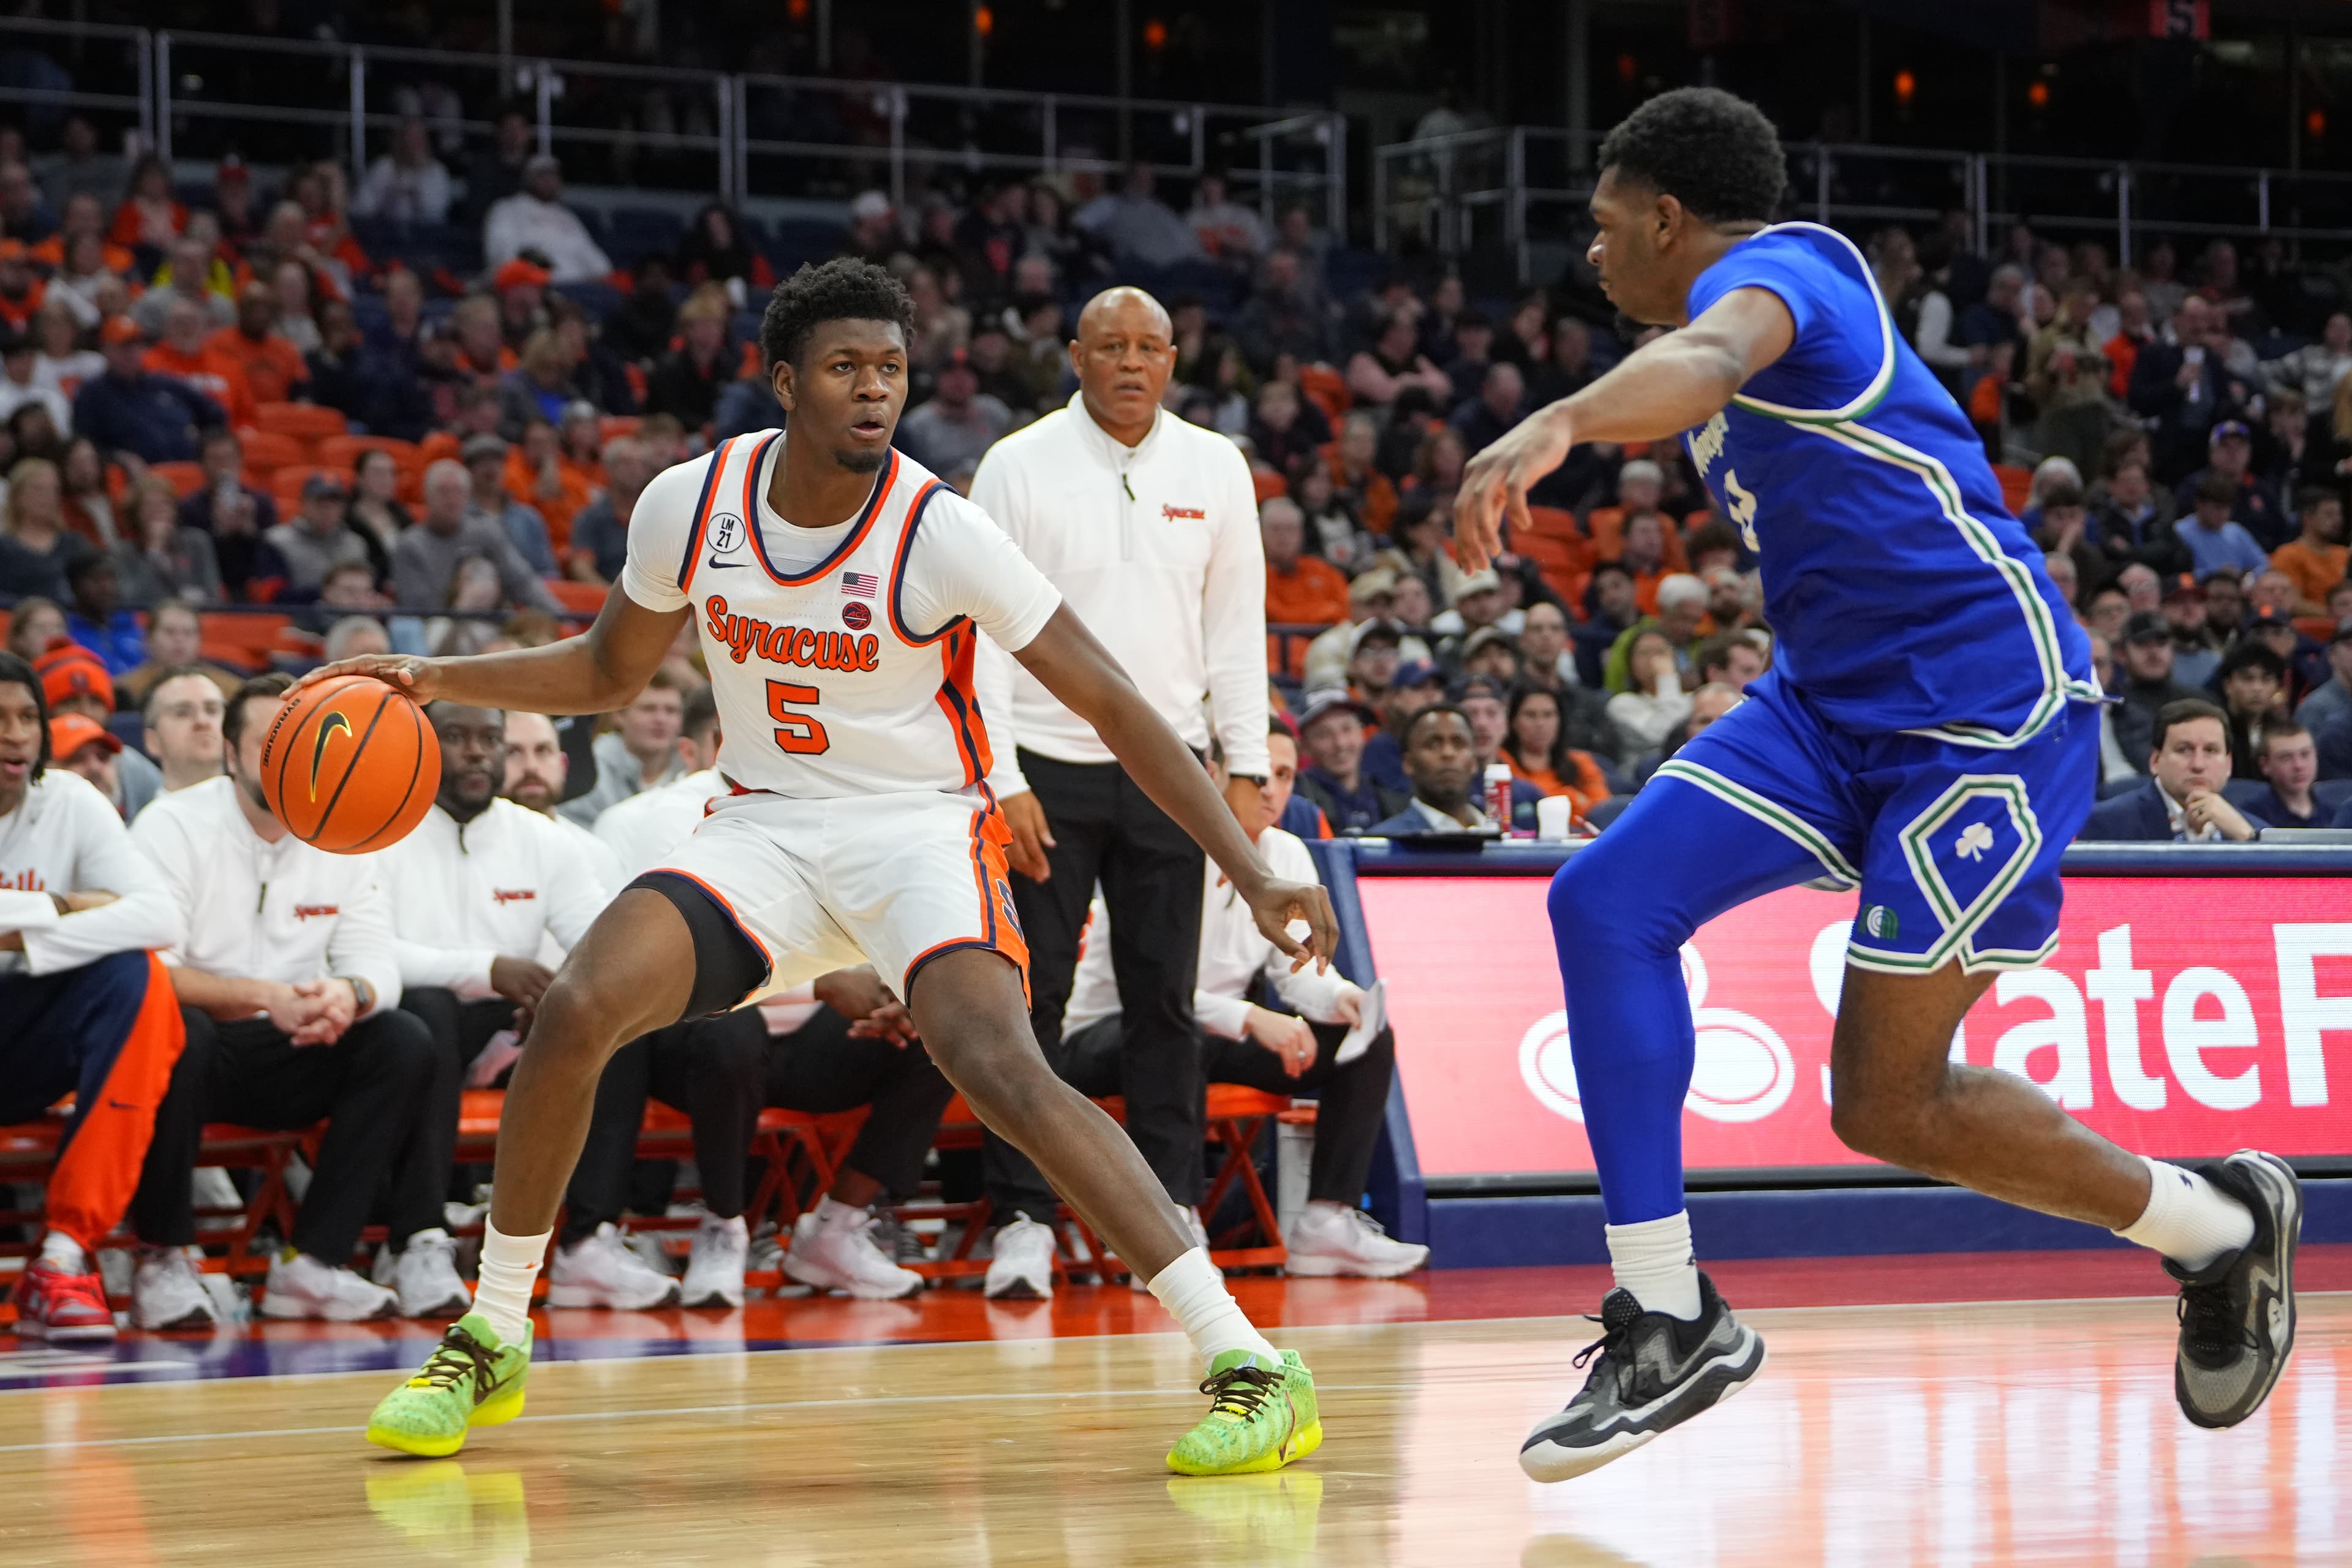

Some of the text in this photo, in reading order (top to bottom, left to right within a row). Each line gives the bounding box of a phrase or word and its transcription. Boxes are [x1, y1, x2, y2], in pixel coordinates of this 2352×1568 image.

[716, 530, 731, 549] 21
[721, 517, 735, 532] LM
[706, 595, 880, 673] Syracuse
[765, 678, 831, 756] 5
[1809, 919, 2263, 1112] ate
